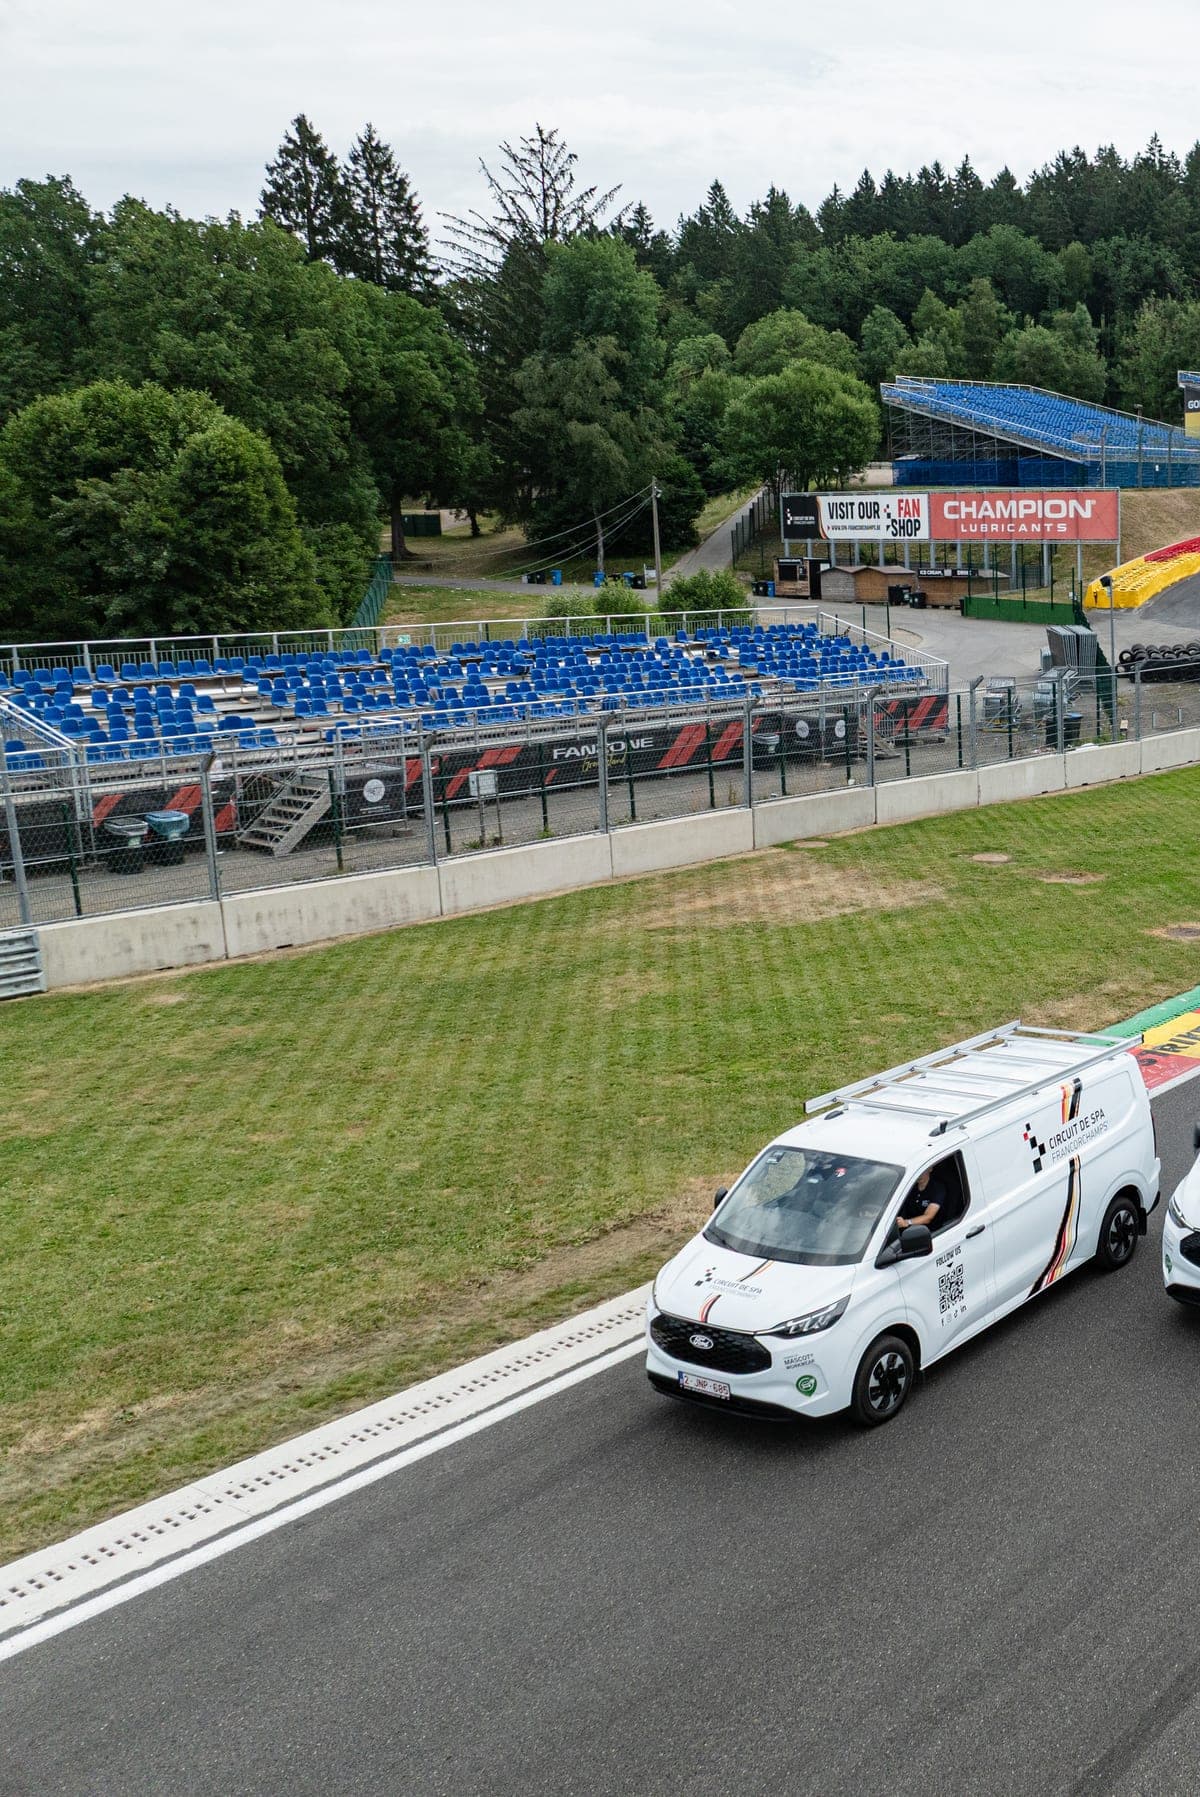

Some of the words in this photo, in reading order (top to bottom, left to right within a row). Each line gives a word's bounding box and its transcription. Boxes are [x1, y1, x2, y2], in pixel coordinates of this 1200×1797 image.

[828, 501, 855, 519] VISIT
[858, 501, 880, 519] OUR
[897, 498, 921, 518] FAN
[943, 499, 1092, 519] CHAMPION
[891, 519, 921, 537] SHOP
[961, 523, 1067, 533] LUBRICANTS
[553, 737, 654, 759] FANONE
[1049, 1123, 1079, 1149] CIRCUIT
[1080, 1116, 1091, 1131] DE
[1091, 1108, 1106, 1124] SPA
[936, 1250, 955, 1267] FOLLOW
[954, 1246, 962, 1256] US
[713, 1279, 739, 1289] CIRCUIT
[750, 1286, 763, 1295] SPA
[693, 1335, 711, 1348] Ford
[784, 1353, 812, 1366] MASCOT
